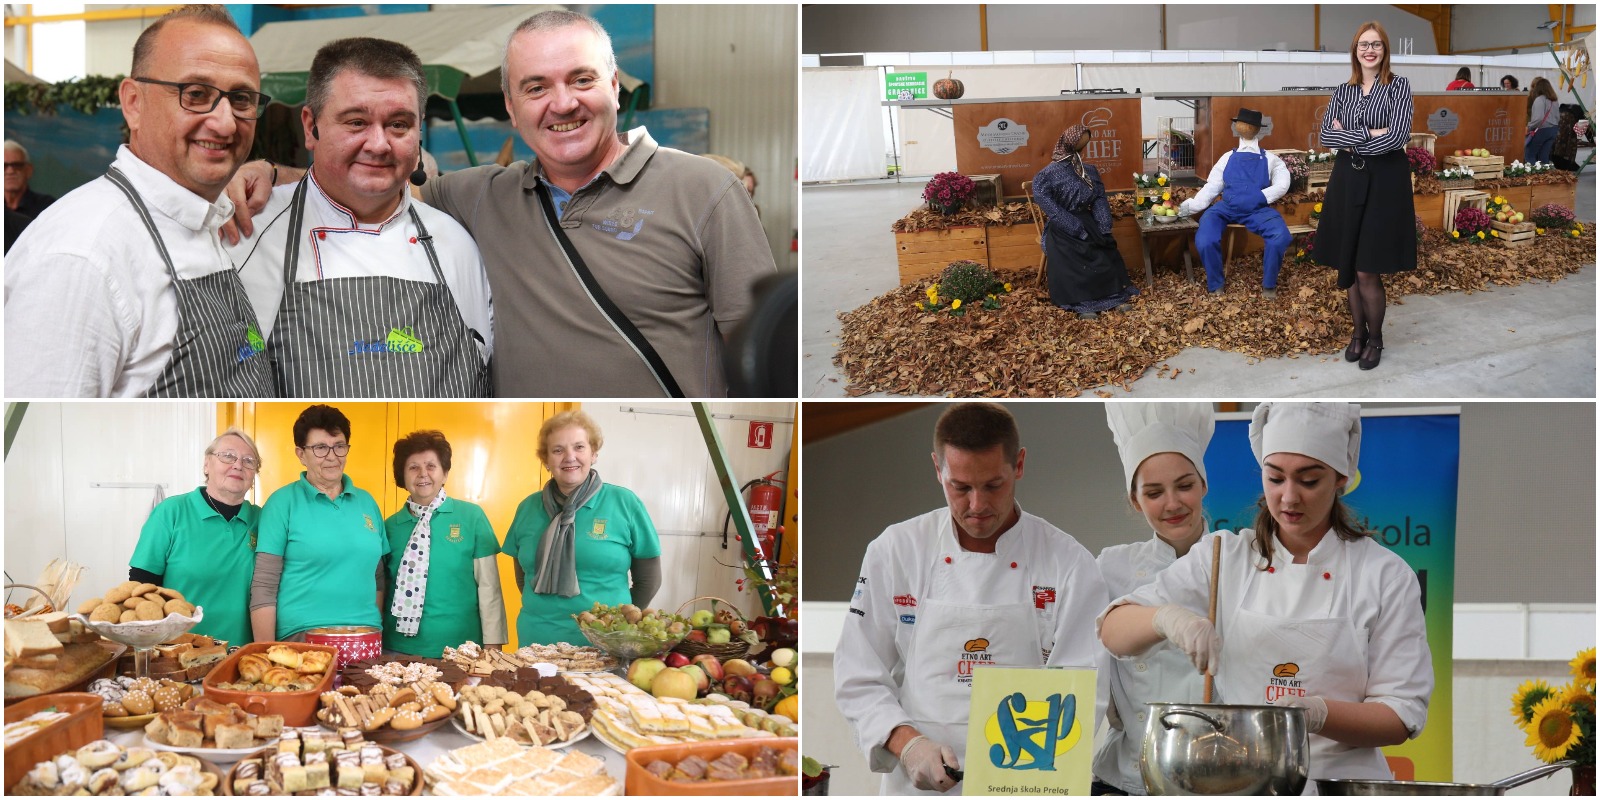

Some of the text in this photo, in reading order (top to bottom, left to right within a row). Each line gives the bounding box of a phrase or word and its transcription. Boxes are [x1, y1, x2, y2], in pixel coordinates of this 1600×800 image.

[1082, 140, 1122, 159] HEF
[1364, 515, 1431, 547] kola
[961, 653, 992, 661] ETNO ART
[1270, 677, 1287, 686] ETNO
[988, 785, 1069, 795] Srednja škola Prelog
